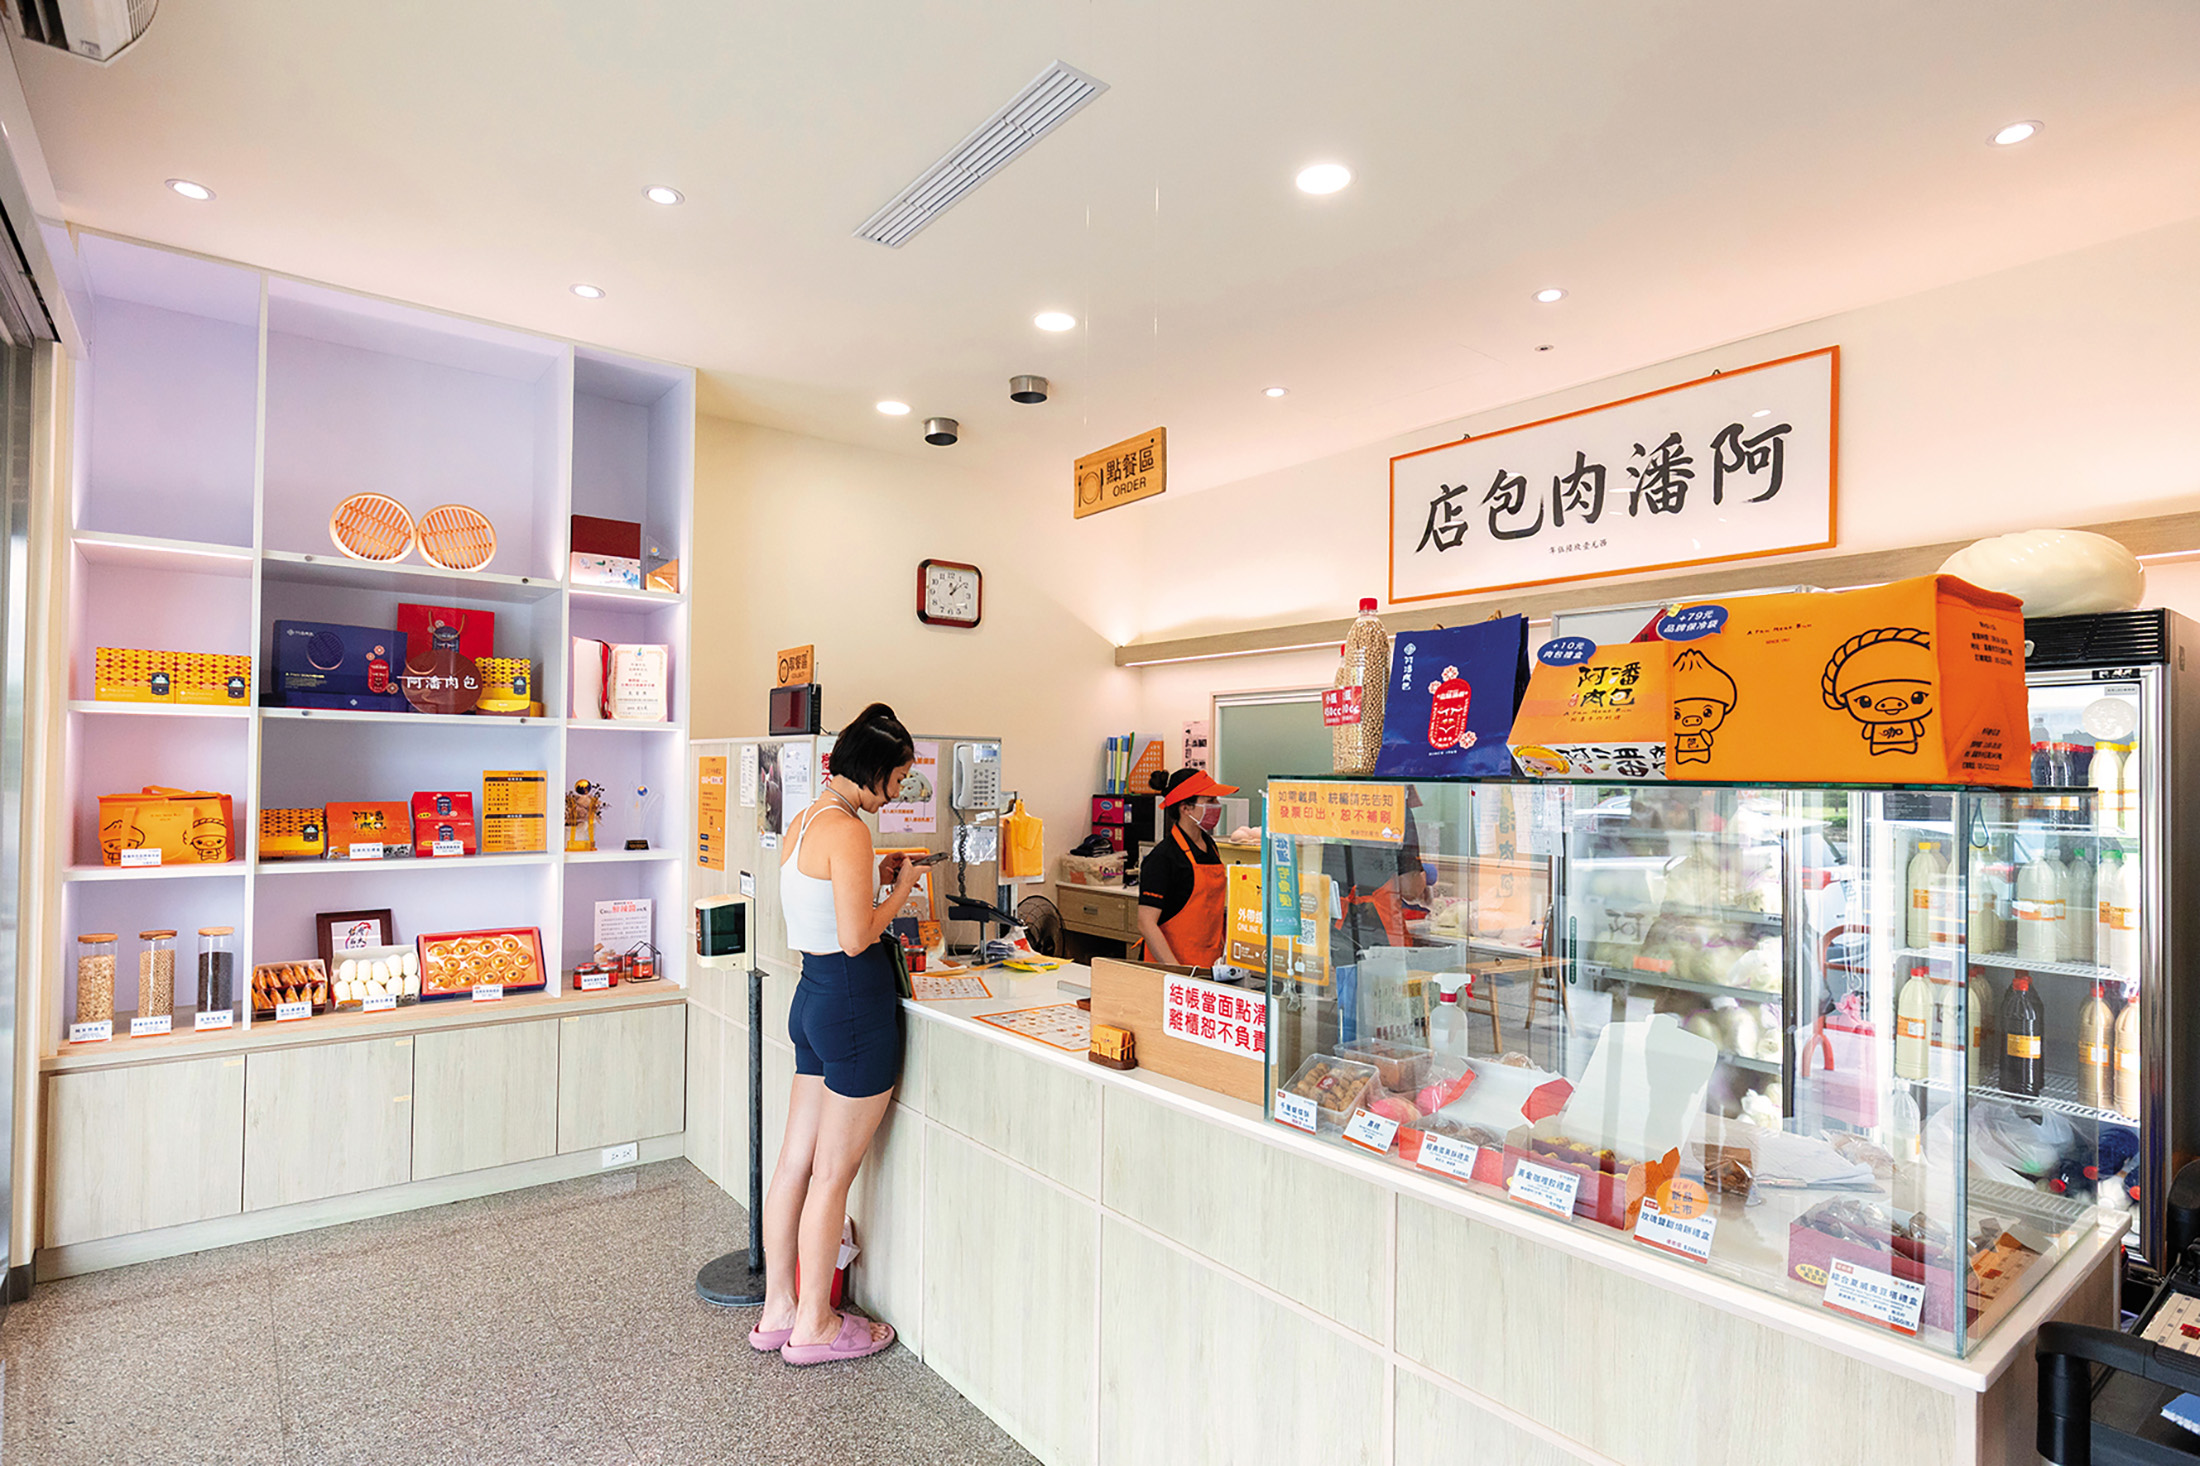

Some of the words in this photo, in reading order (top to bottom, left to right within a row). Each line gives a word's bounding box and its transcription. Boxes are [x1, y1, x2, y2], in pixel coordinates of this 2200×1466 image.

[1106, 445, 1154, 485] 點餐區
[1113, 476, 1146, 497] ORDER
[1679, 609, 1714, 622] +79元
[1663, 620, 1720, 633] 品牌保冷袋
[1553, 641, 1585, 651] +10元
[1543, 651, 1584, 660] 肉包禮盒
[1578, 661, 1641, 687] 阿潘
[406, 675, 478, 690] 阿潘肉包
[1580, 688, 1635, 707] 肉包
[1237, 923, 1259, 935] ONLINE
[1169, 983, 1266, 1027] 結帳當面點清
[1169, 1008, 1266, 1053] 離櫃恕不負責
[1672, 1190, 1693, 1202] 新品
[1671, 1203, 1693, 1215] 上市
